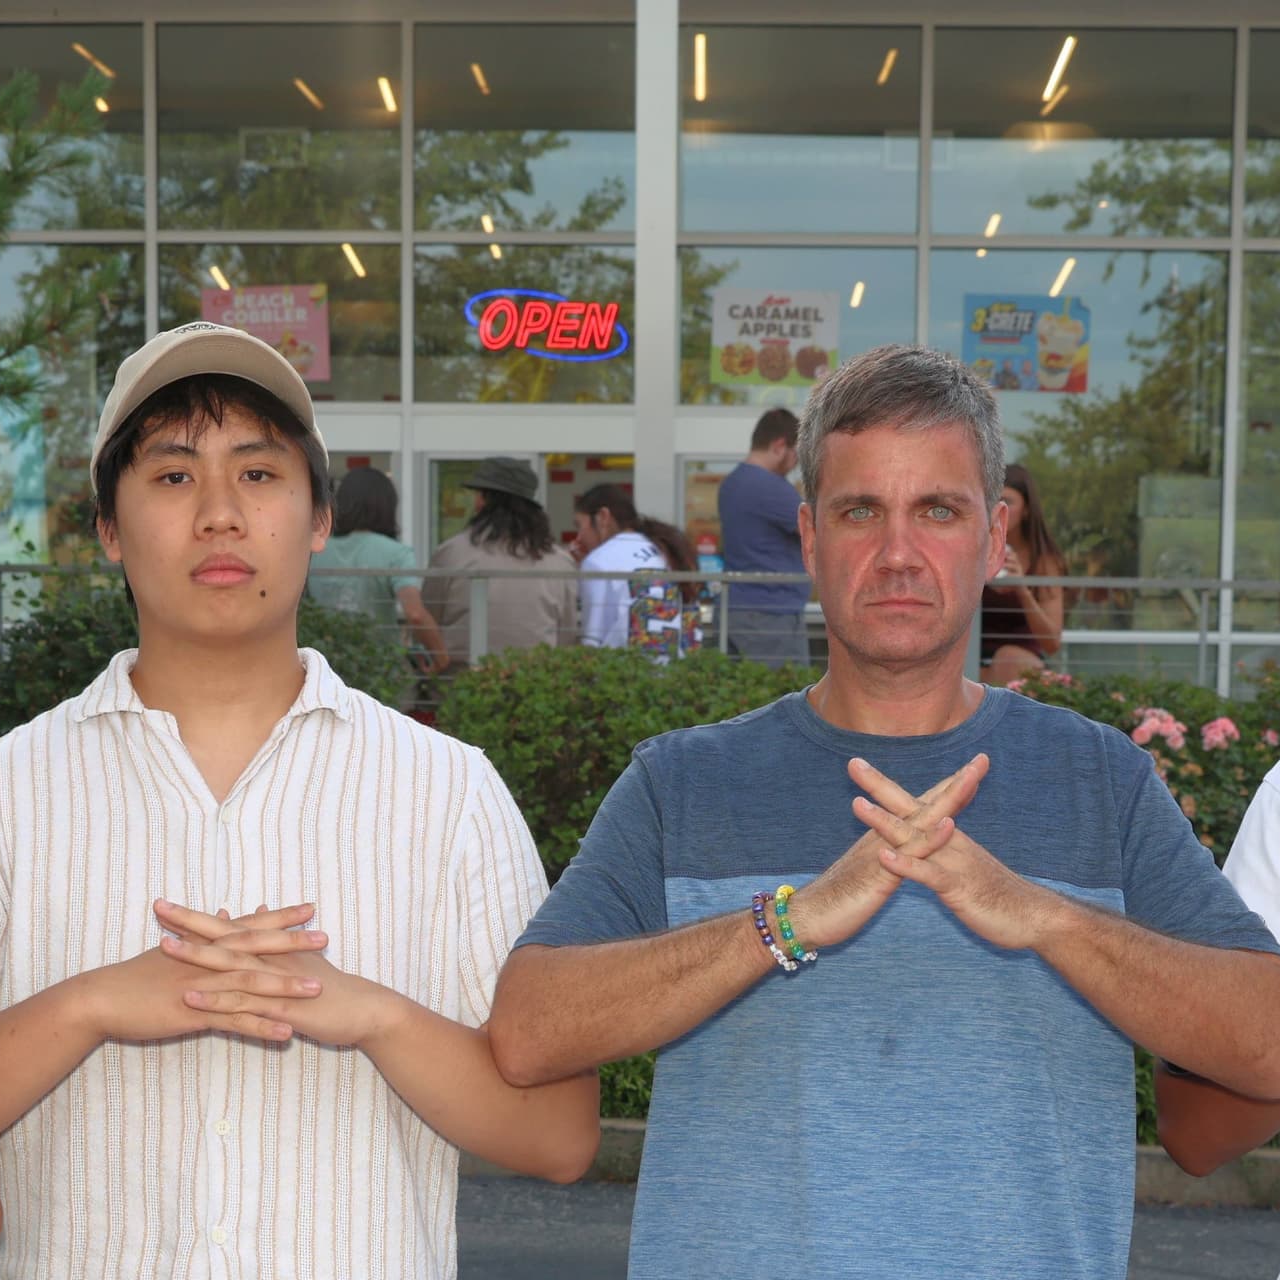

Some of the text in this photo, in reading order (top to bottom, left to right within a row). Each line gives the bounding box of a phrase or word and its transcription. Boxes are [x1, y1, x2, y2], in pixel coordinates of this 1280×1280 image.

[233, 293, 294, 308] PEACH
[223, 307, 307, 323] COBBLER
[728, 304, 824, 322] CARAMEL
[479, 298, 619, 350] OPEN
[738, 322, 813, 338] APPLES
